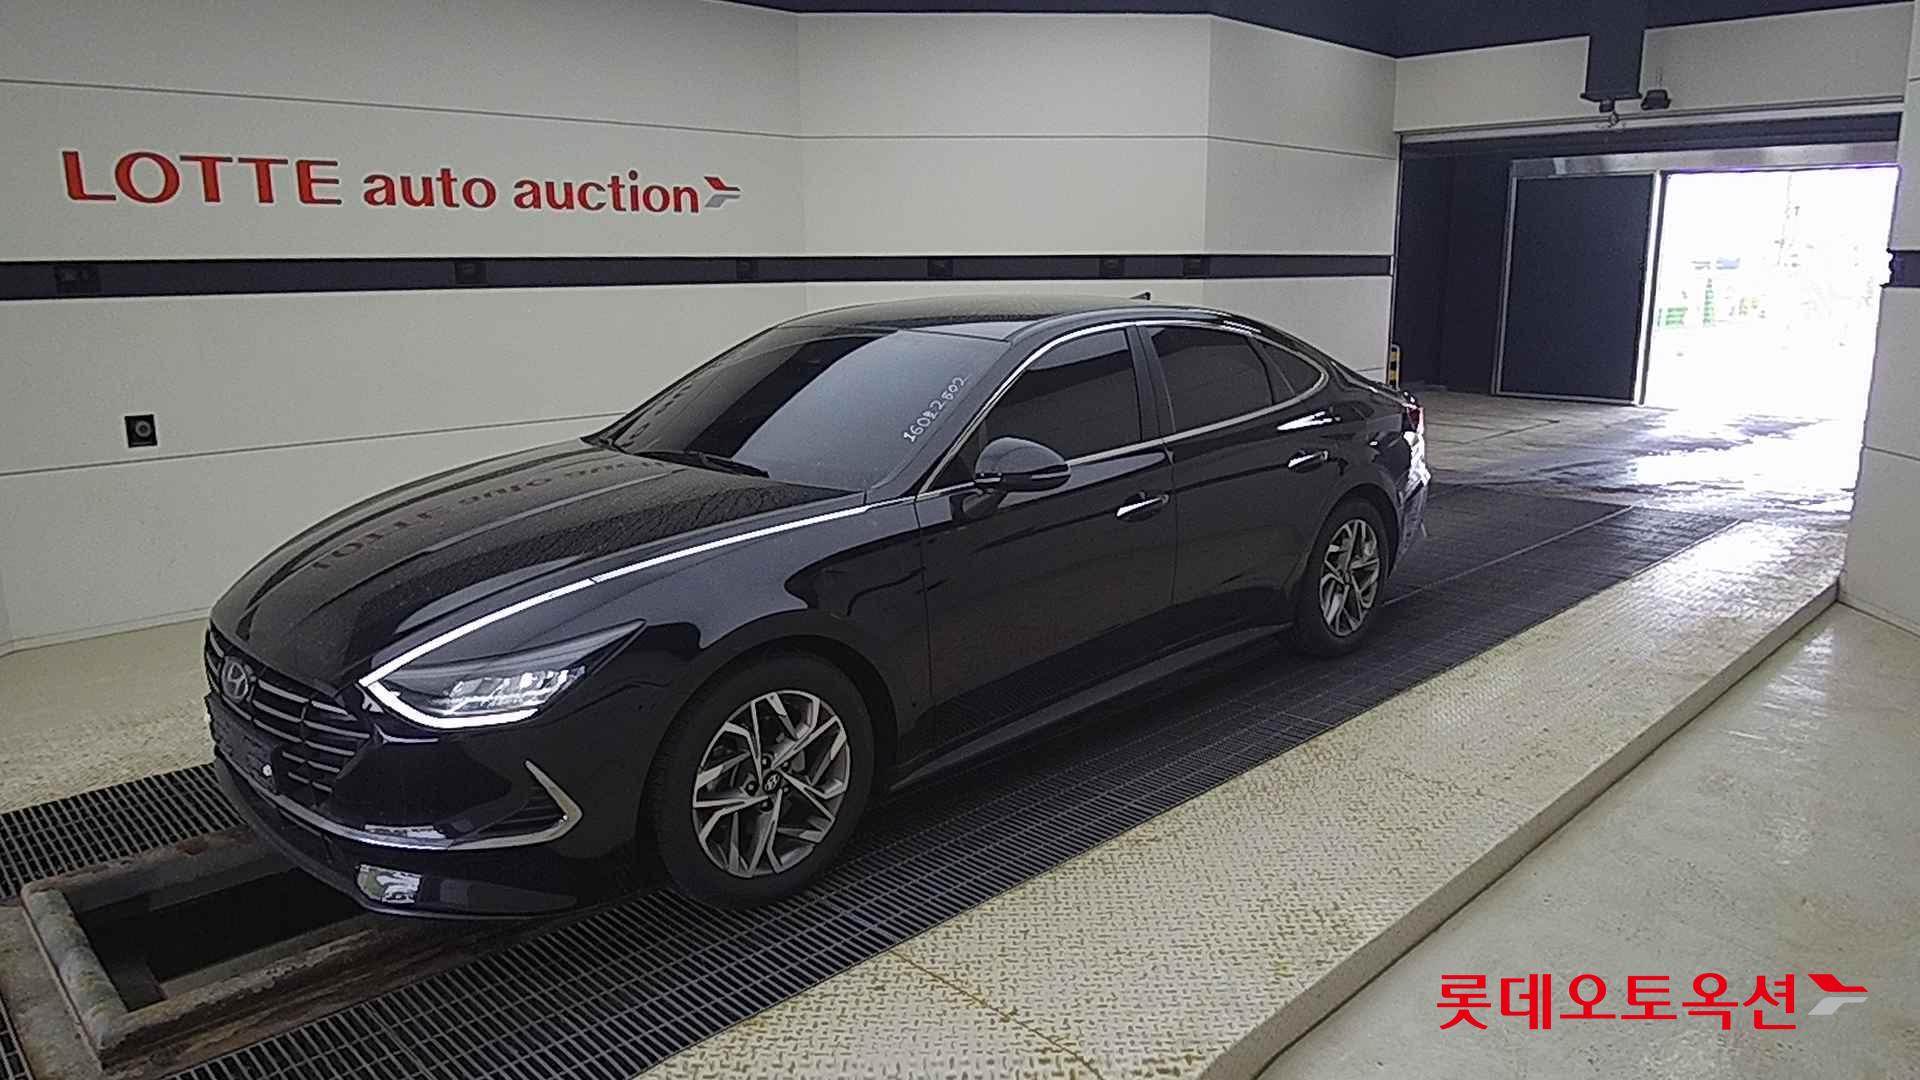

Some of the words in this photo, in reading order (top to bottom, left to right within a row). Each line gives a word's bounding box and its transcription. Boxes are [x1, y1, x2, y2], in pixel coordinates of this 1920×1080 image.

[61, 150, 343, 205] LOTTE
[362, 167, 497, 209] auto
[513, 170, 700, 213] auction
